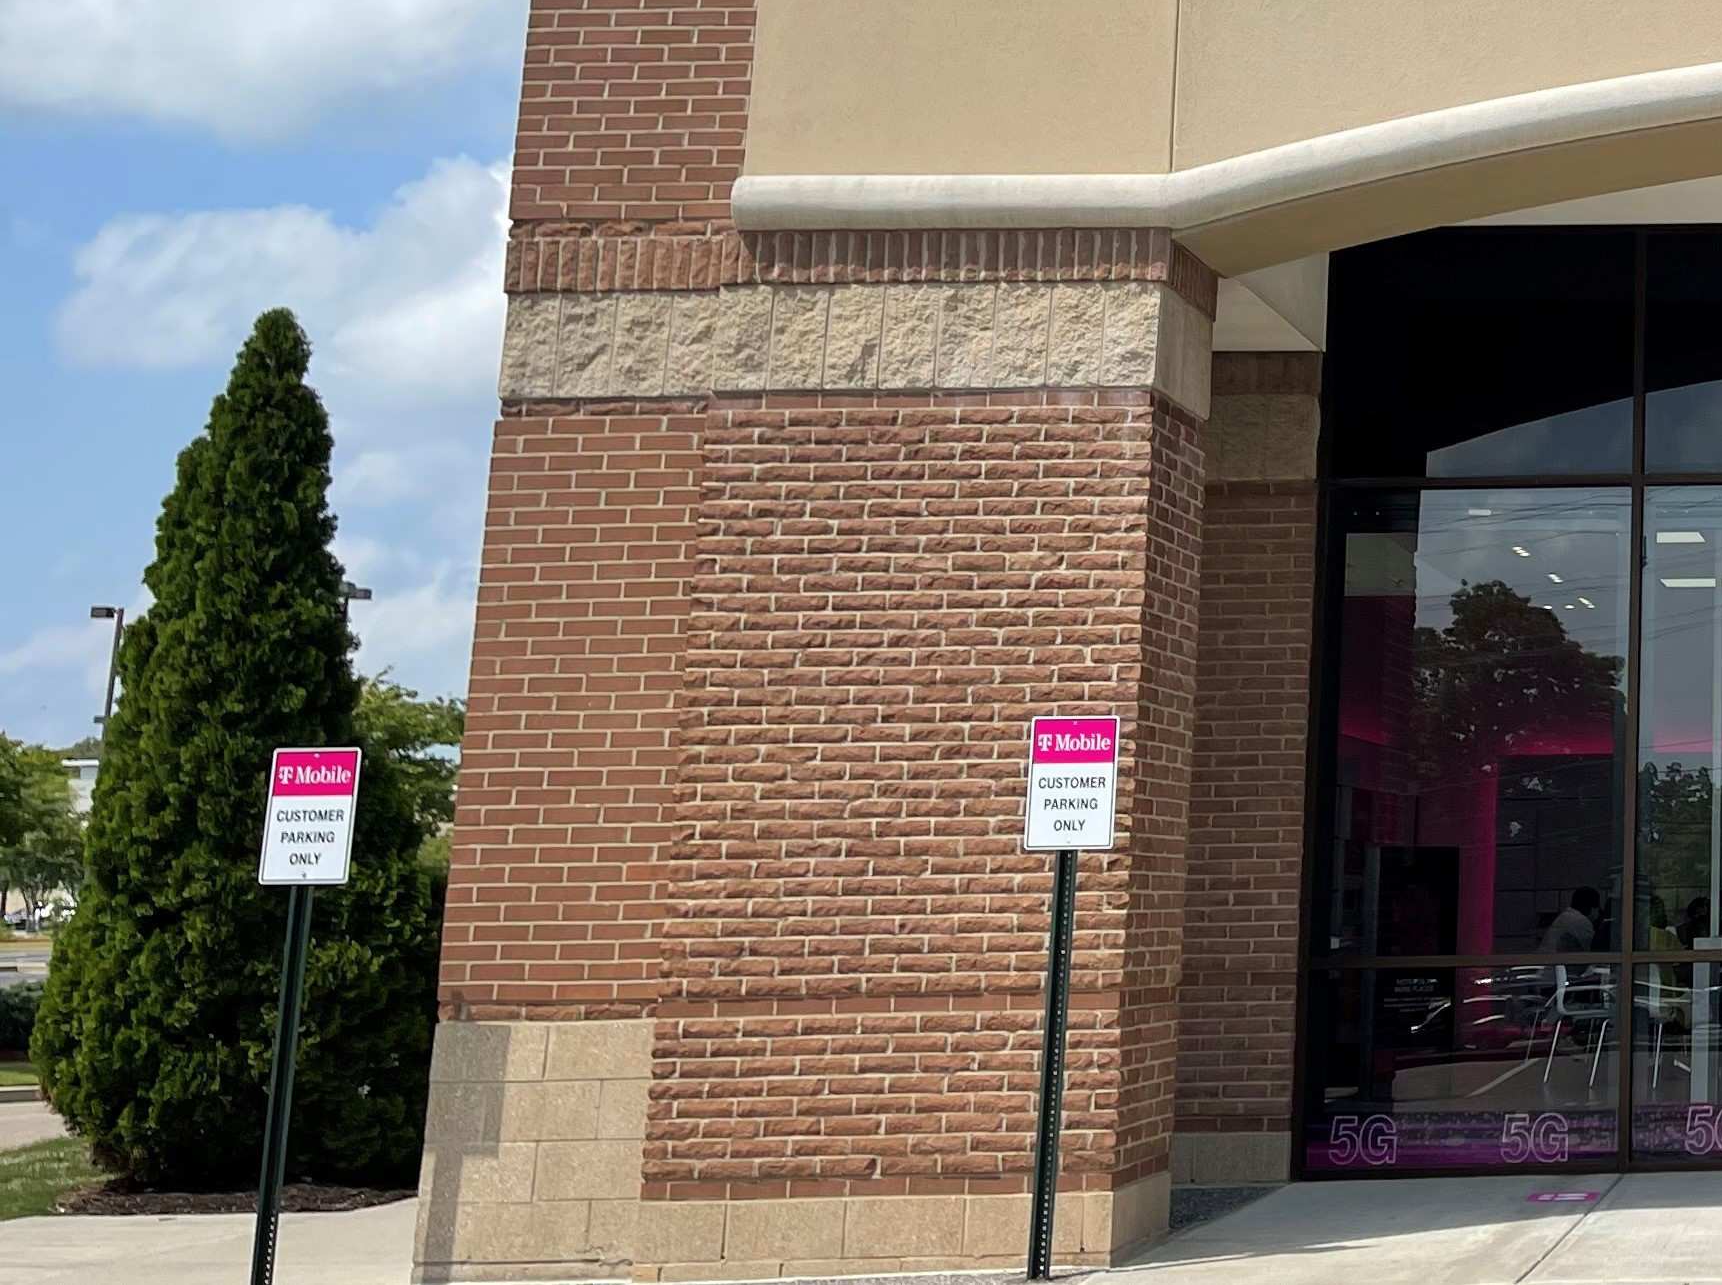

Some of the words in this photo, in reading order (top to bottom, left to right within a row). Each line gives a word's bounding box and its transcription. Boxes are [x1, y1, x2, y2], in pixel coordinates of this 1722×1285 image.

[1055, 734, 1111, 751] Mobile
[295, 765, 351, 784] Mobile
[1038, 777, 1106, 789] CUSTOMER
[1044, 798, 1098, 810] PARKING
[276, 809, 344, 822] CUSTOMER
[1054, 819, 1086, 832] ONLY
[280, 831, 335, 843] PARKING
[289, 853, 322, 865] ONLY
[1329, 1114, 1398, 1165] 5G
[1500, 1113, 1569, 1163] 5G
